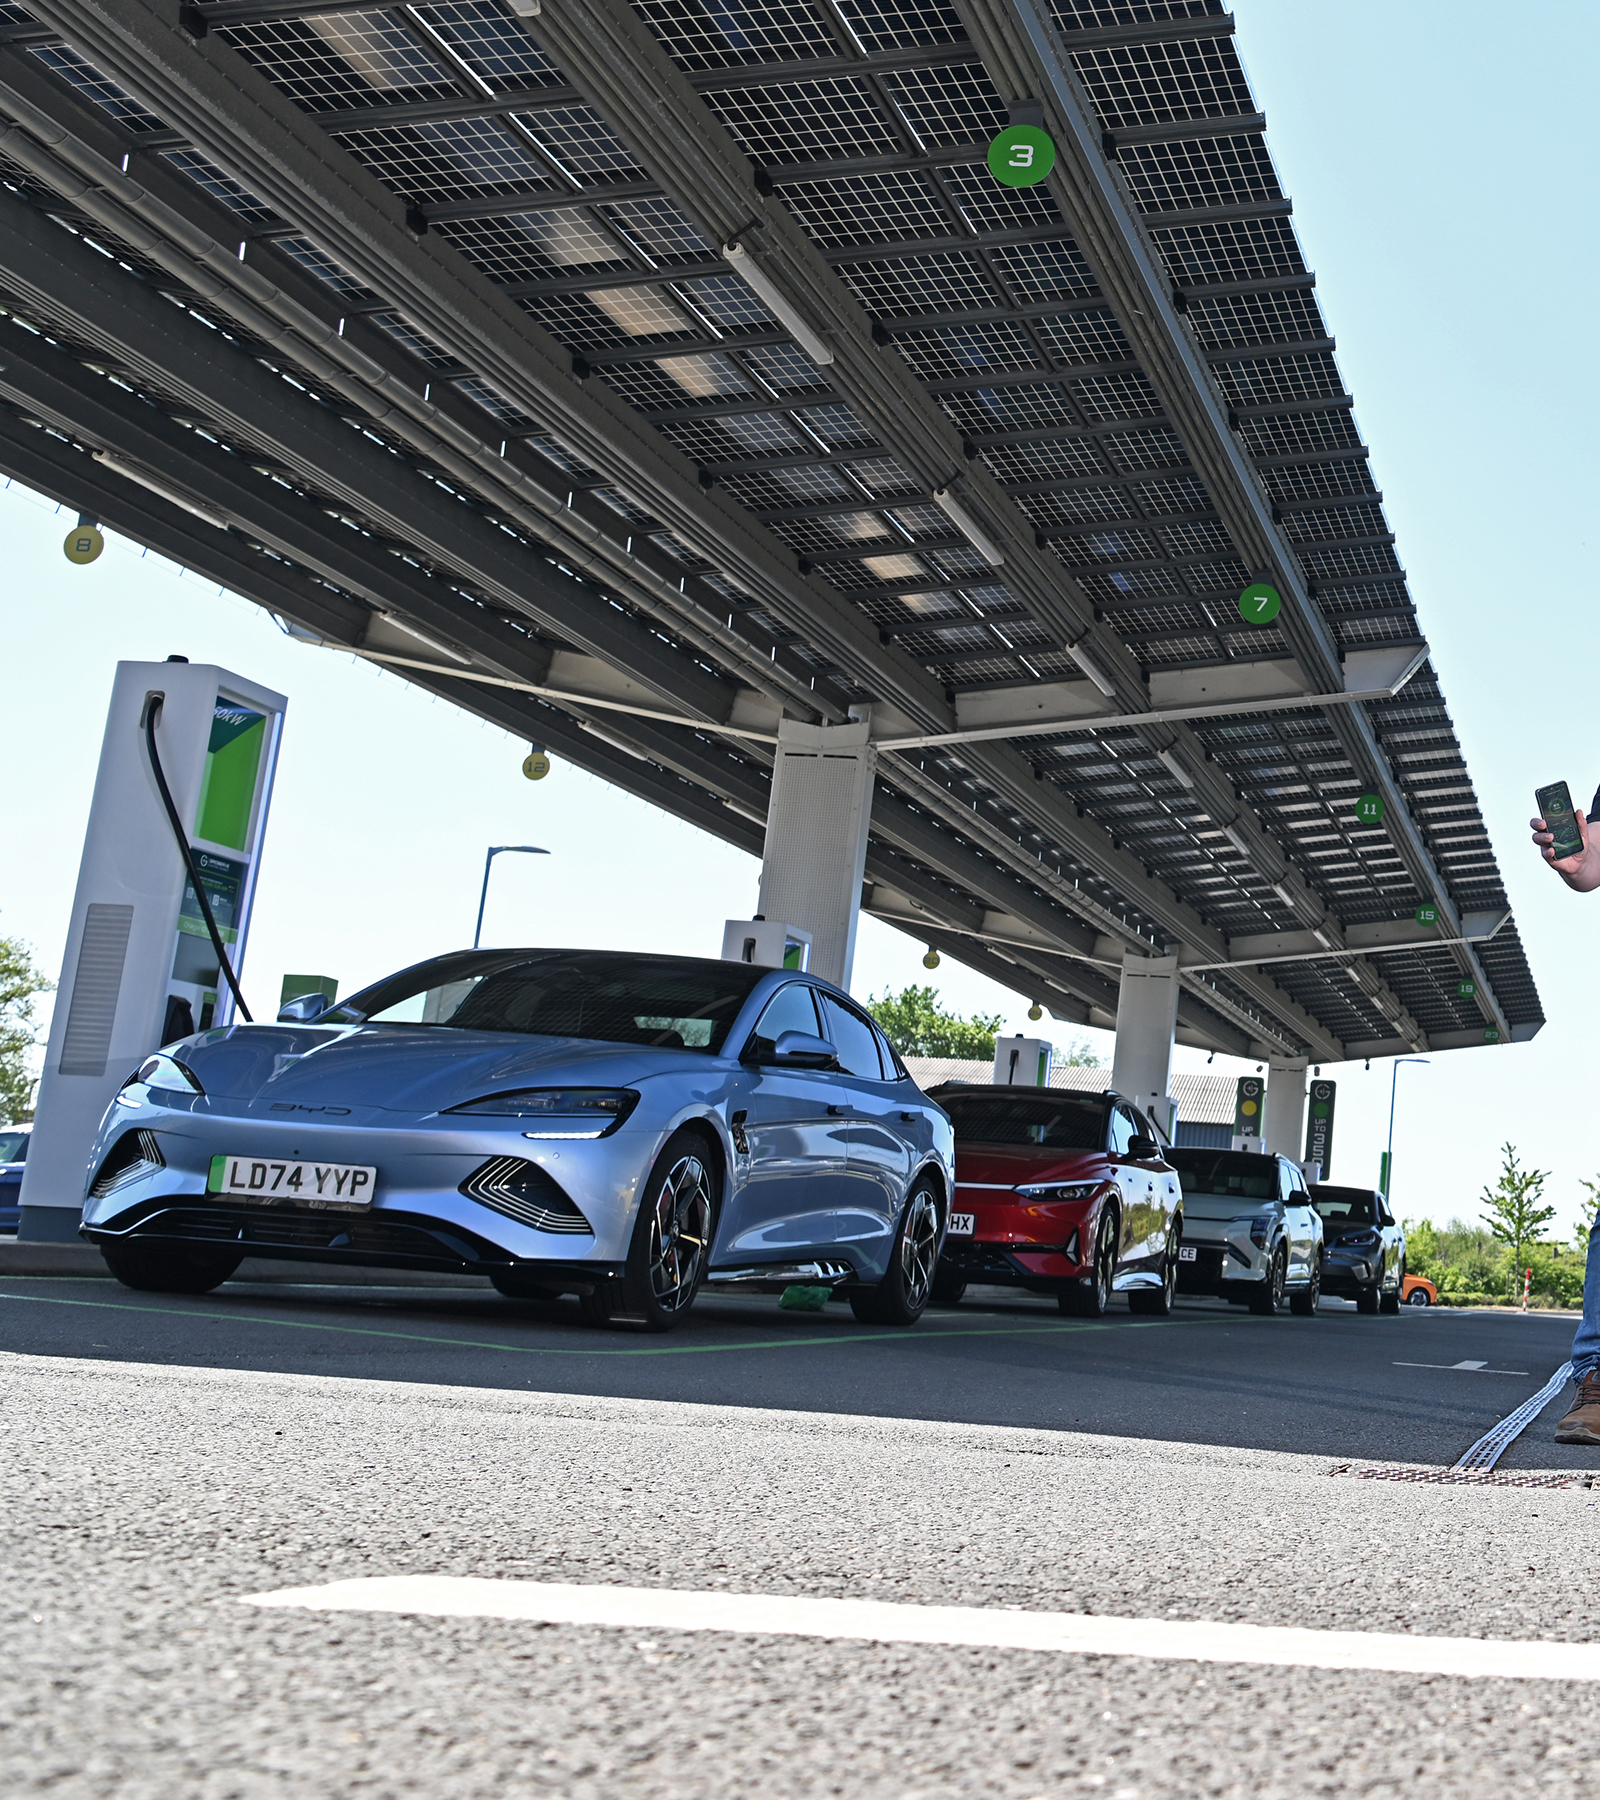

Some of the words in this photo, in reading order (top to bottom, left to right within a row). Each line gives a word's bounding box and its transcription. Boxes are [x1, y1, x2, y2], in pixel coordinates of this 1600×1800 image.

[1008, 145, 1034, 167] 3
[76, 538, 92, 552] 8
[1253, 597, 1268, 612] 7
[527, 761, 546, 773] 12
[1363, 803, 1377, 815] 11
[1420, 910, 1435, 920] 15
[1461, 984, 1474, 993] 19
[1484, 1031, 1499, 1039] 23
[269, 1102, 352, 1116] BYD
[229, 1161, 303, 1192] LD74
[315, 1167, 369, 1197] YYP
[950, 1215, 970, 1231] HX
[1181, 1248, 1195, 1259] CE
